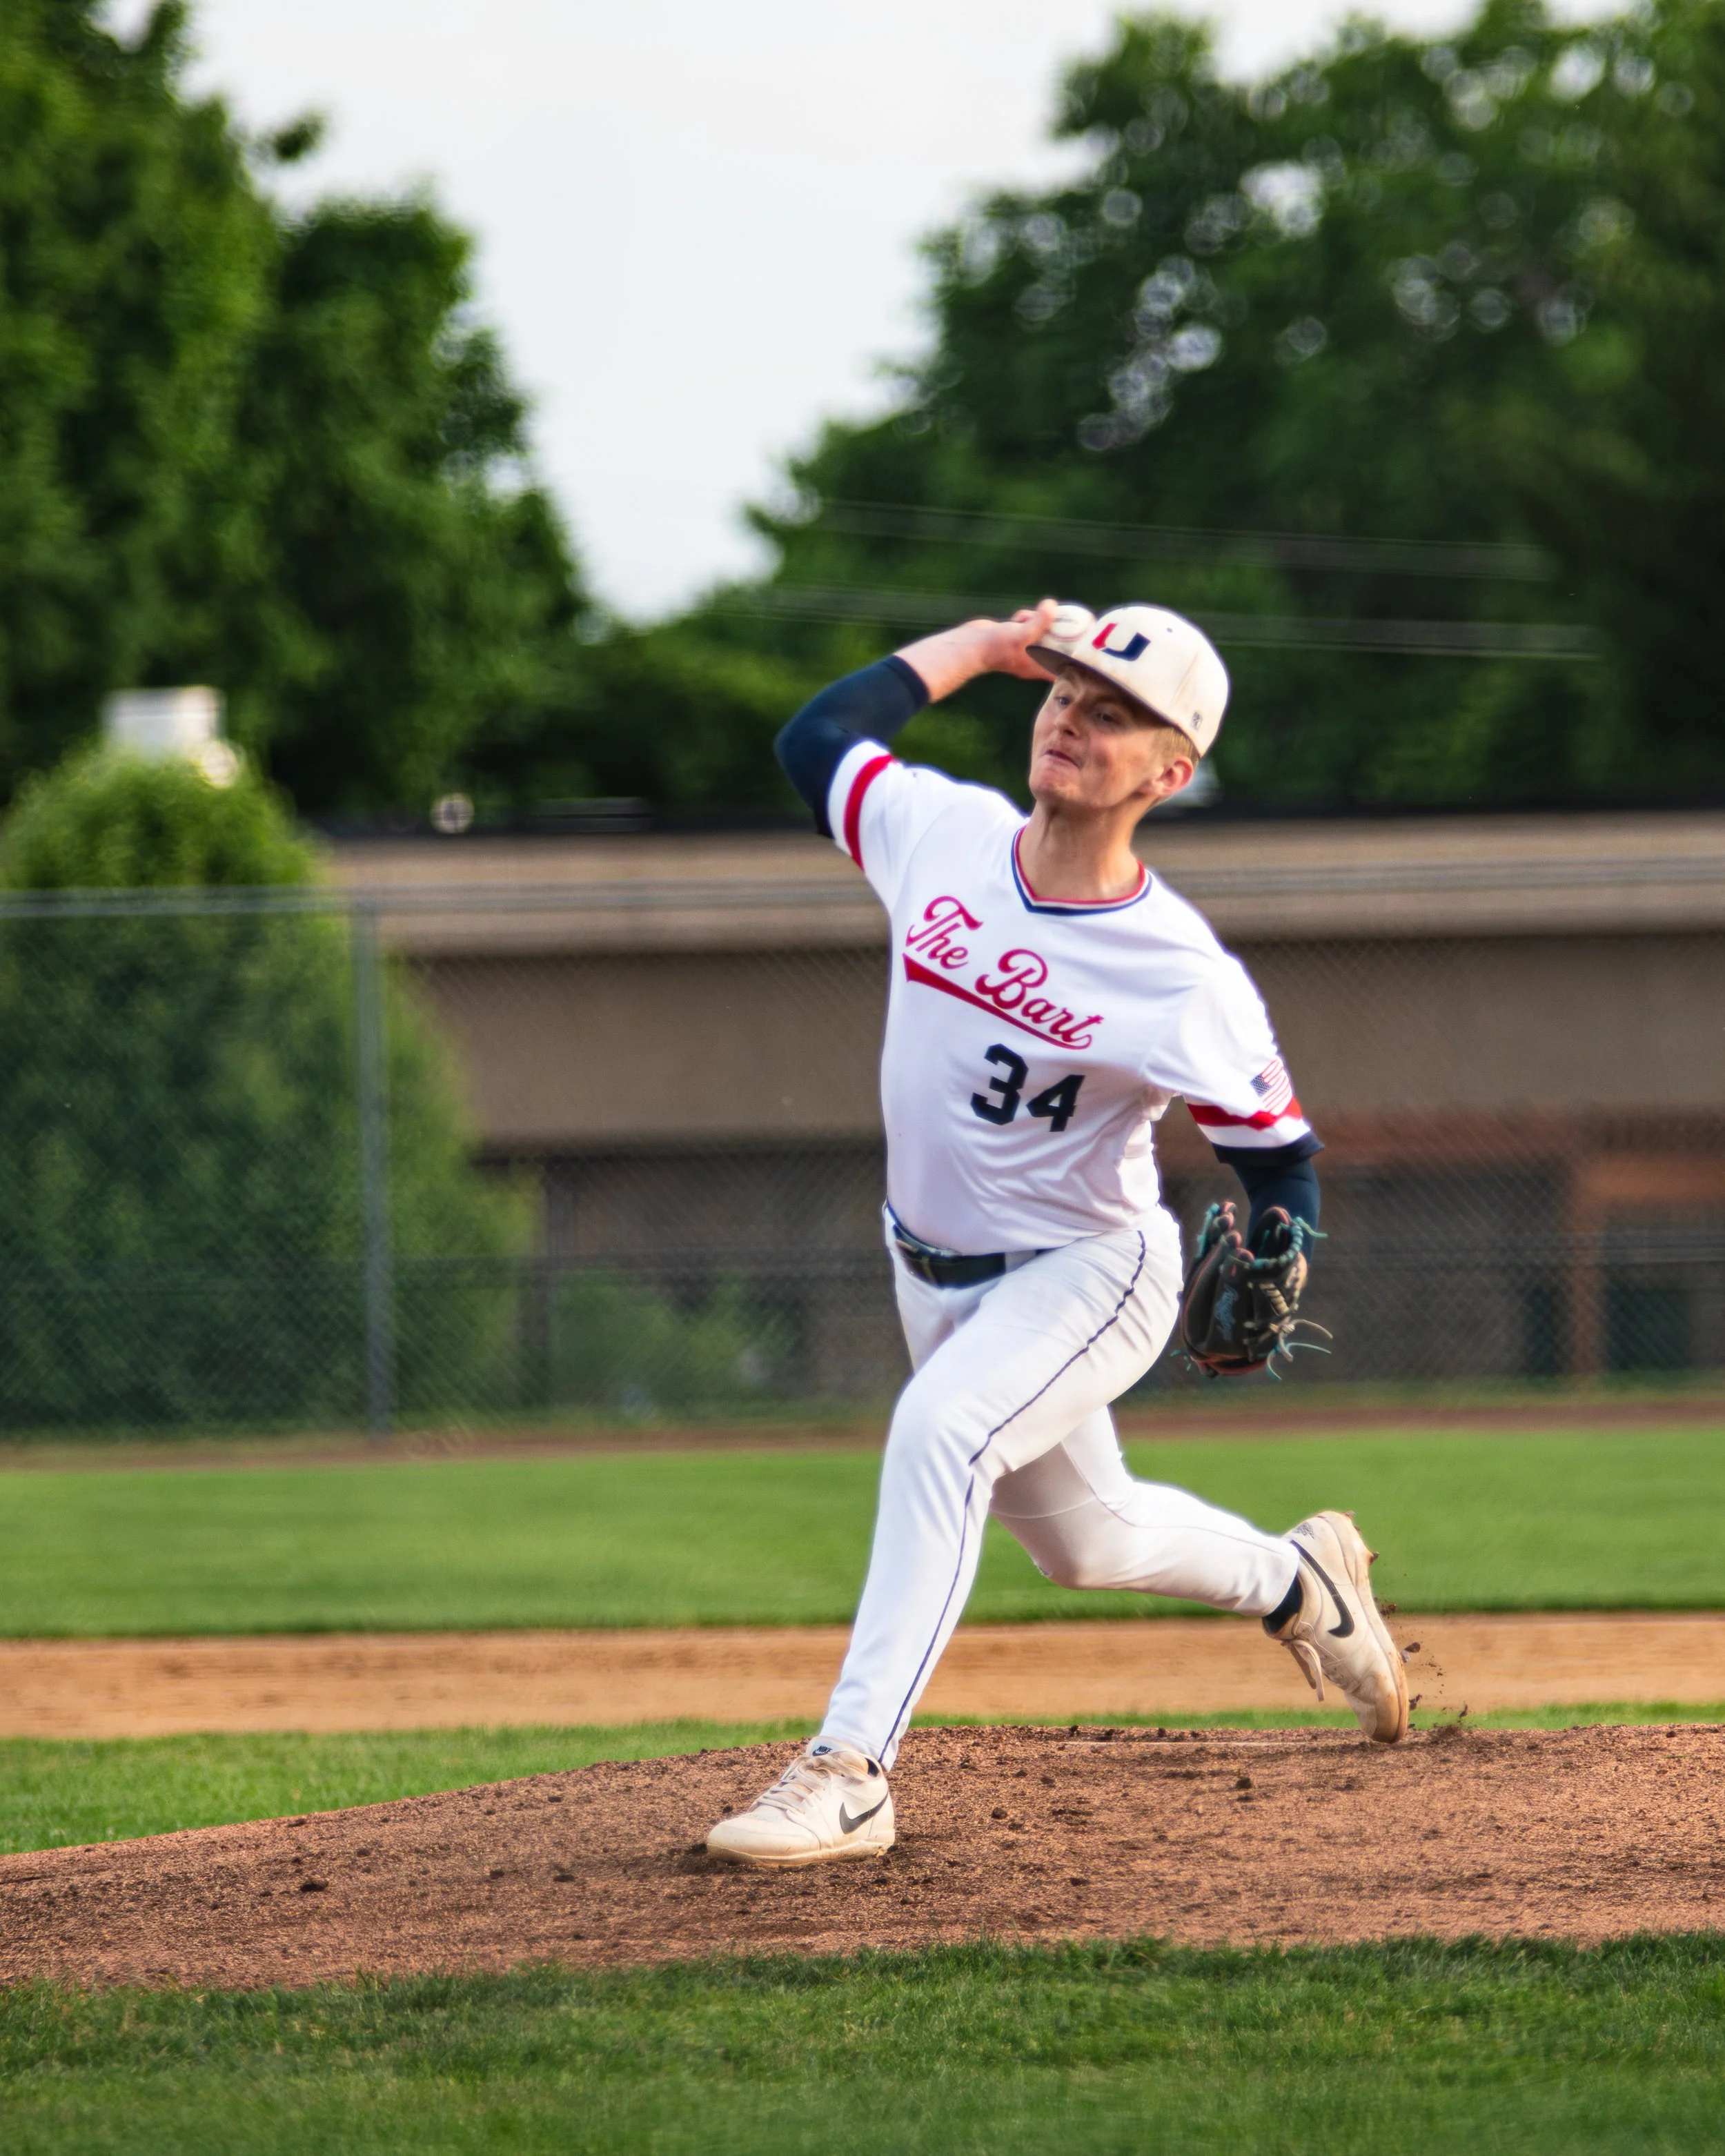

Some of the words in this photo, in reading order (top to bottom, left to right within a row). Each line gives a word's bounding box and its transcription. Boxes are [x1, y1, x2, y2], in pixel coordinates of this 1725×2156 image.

[1092, 622, 1151, 662] U
[905, 896, 983, 969] The
[974, 949, 1105, 1043] Bart
[970, 1043, 1086, 1132] 34
